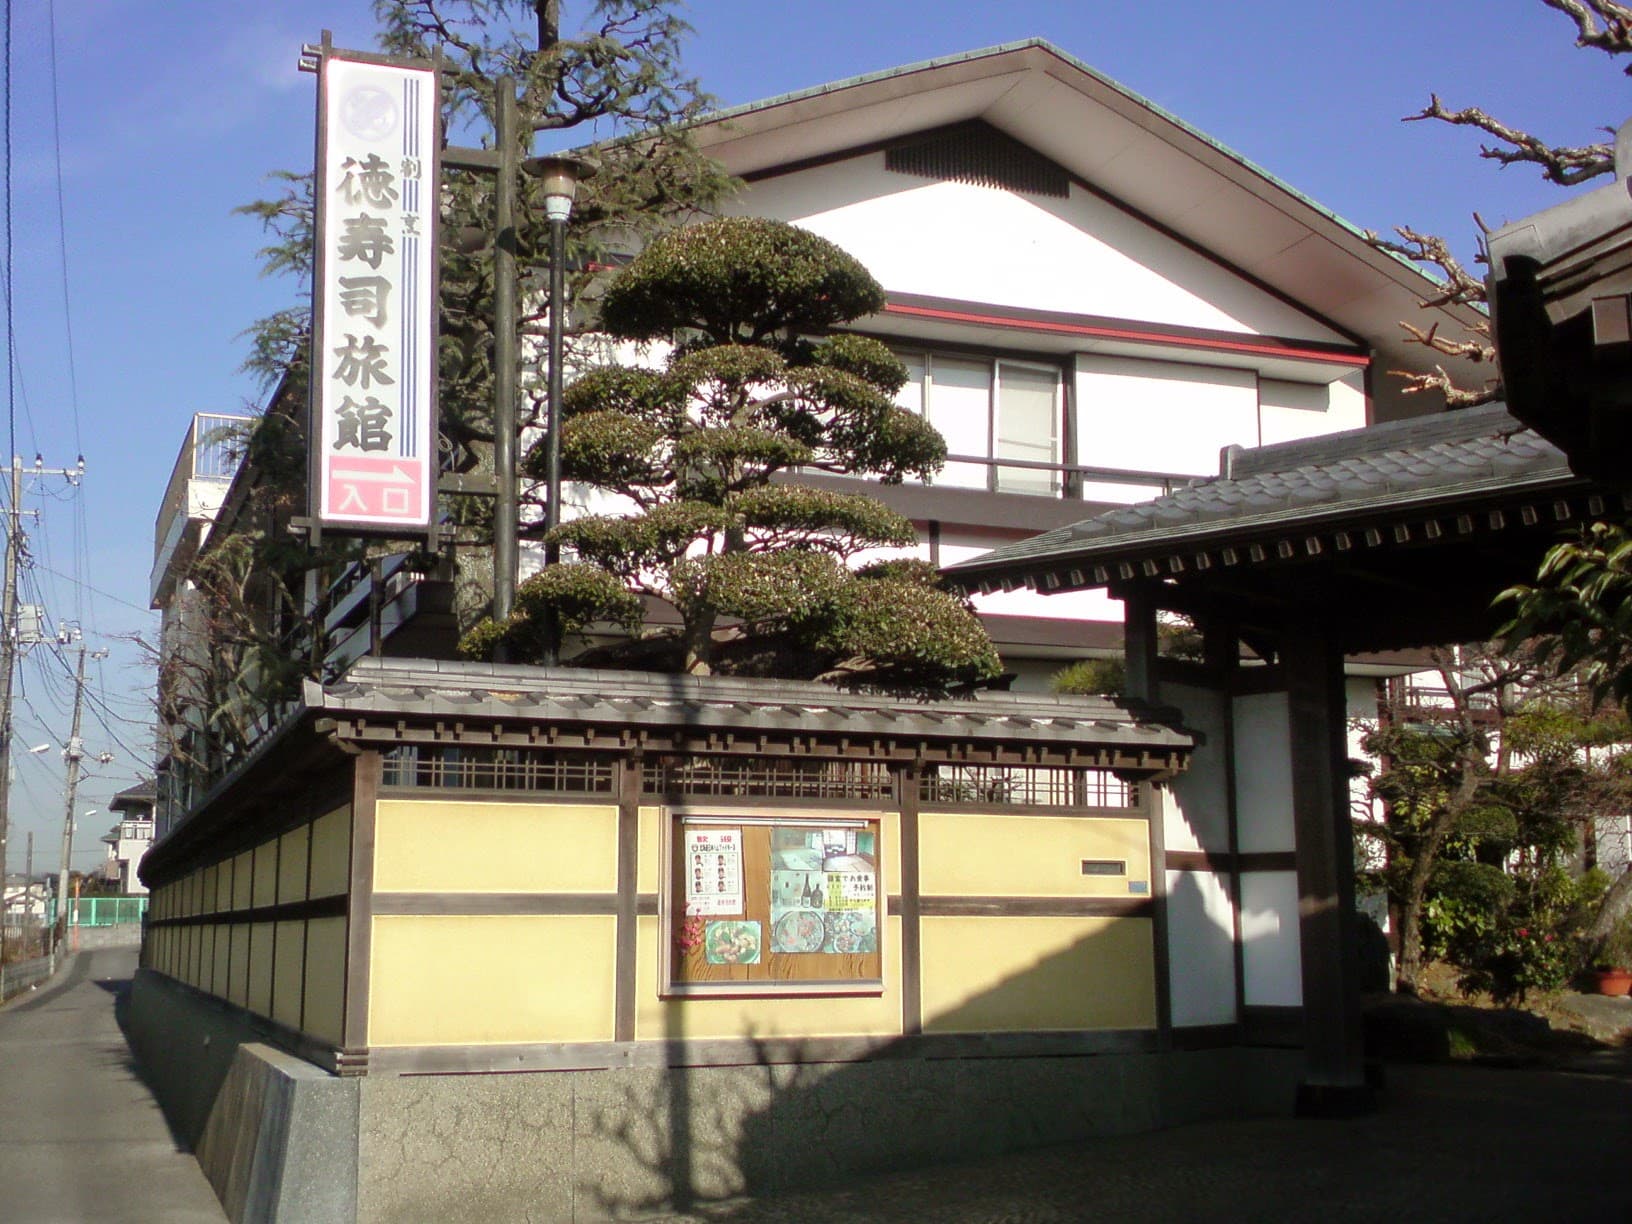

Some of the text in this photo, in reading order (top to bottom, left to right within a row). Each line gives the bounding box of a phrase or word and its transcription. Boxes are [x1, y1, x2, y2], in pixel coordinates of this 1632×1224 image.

[400, 157, 422, 236] 割烹
[332, 153, 399, 452] 徳寿司旅館
[338, 483, 409, 514] 入口
